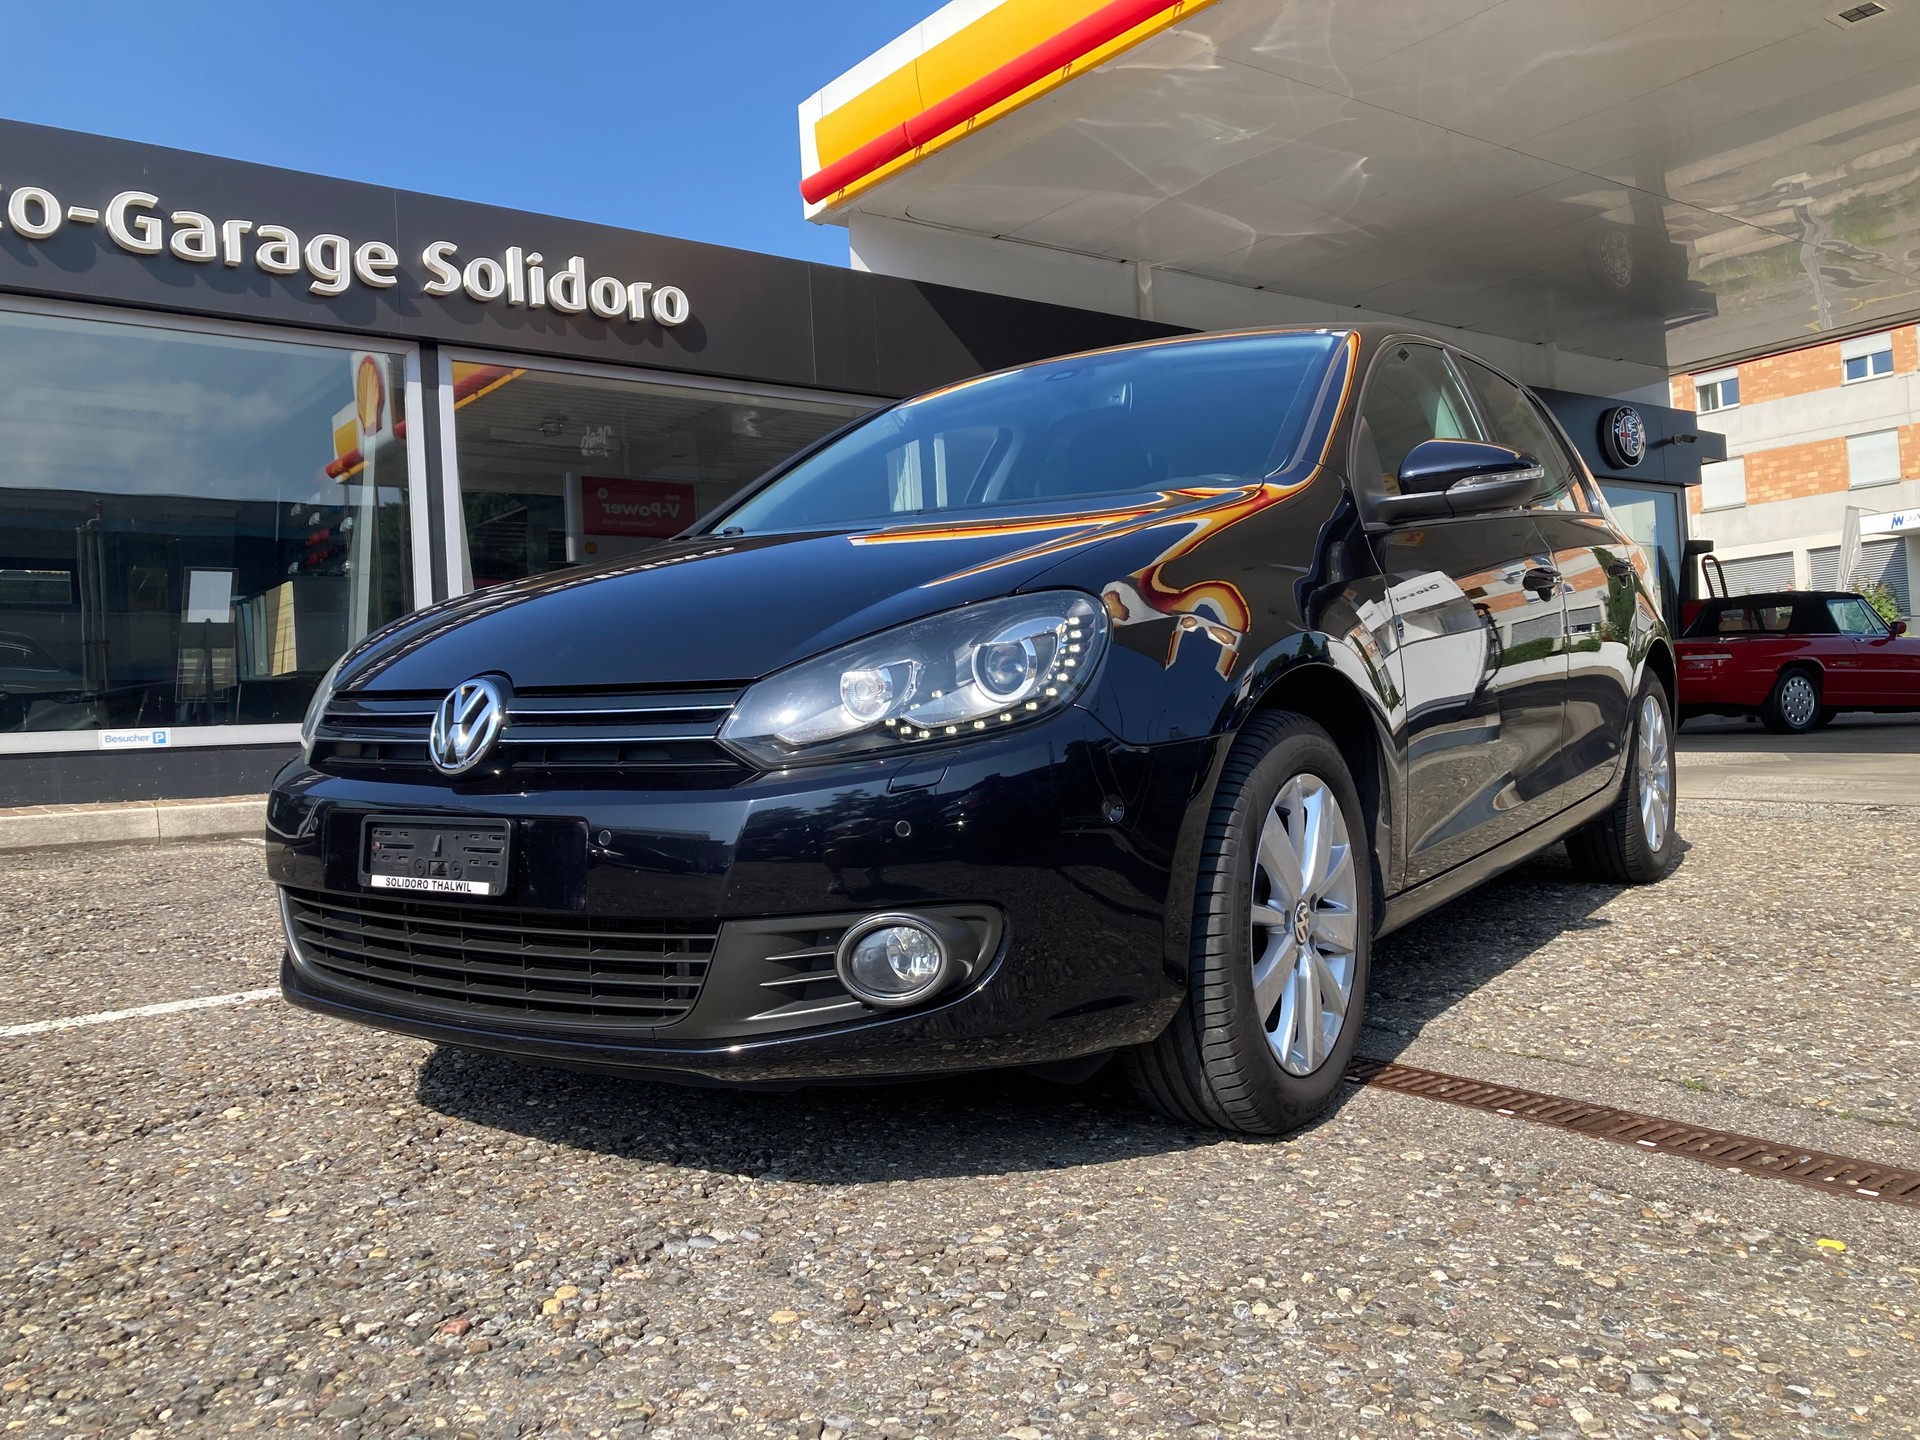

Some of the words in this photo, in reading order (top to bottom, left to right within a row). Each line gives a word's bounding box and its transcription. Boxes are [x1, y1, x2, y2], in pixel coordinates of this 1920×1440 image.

[0, 187, 398, 296] o-Garage
[422, 240, 689, 327] Solidoro
[104, 734, 149, 744] Besucher
[385, 877, 429, 890] SOLIDORO
[431, 880, 472, 893] THALWIL
